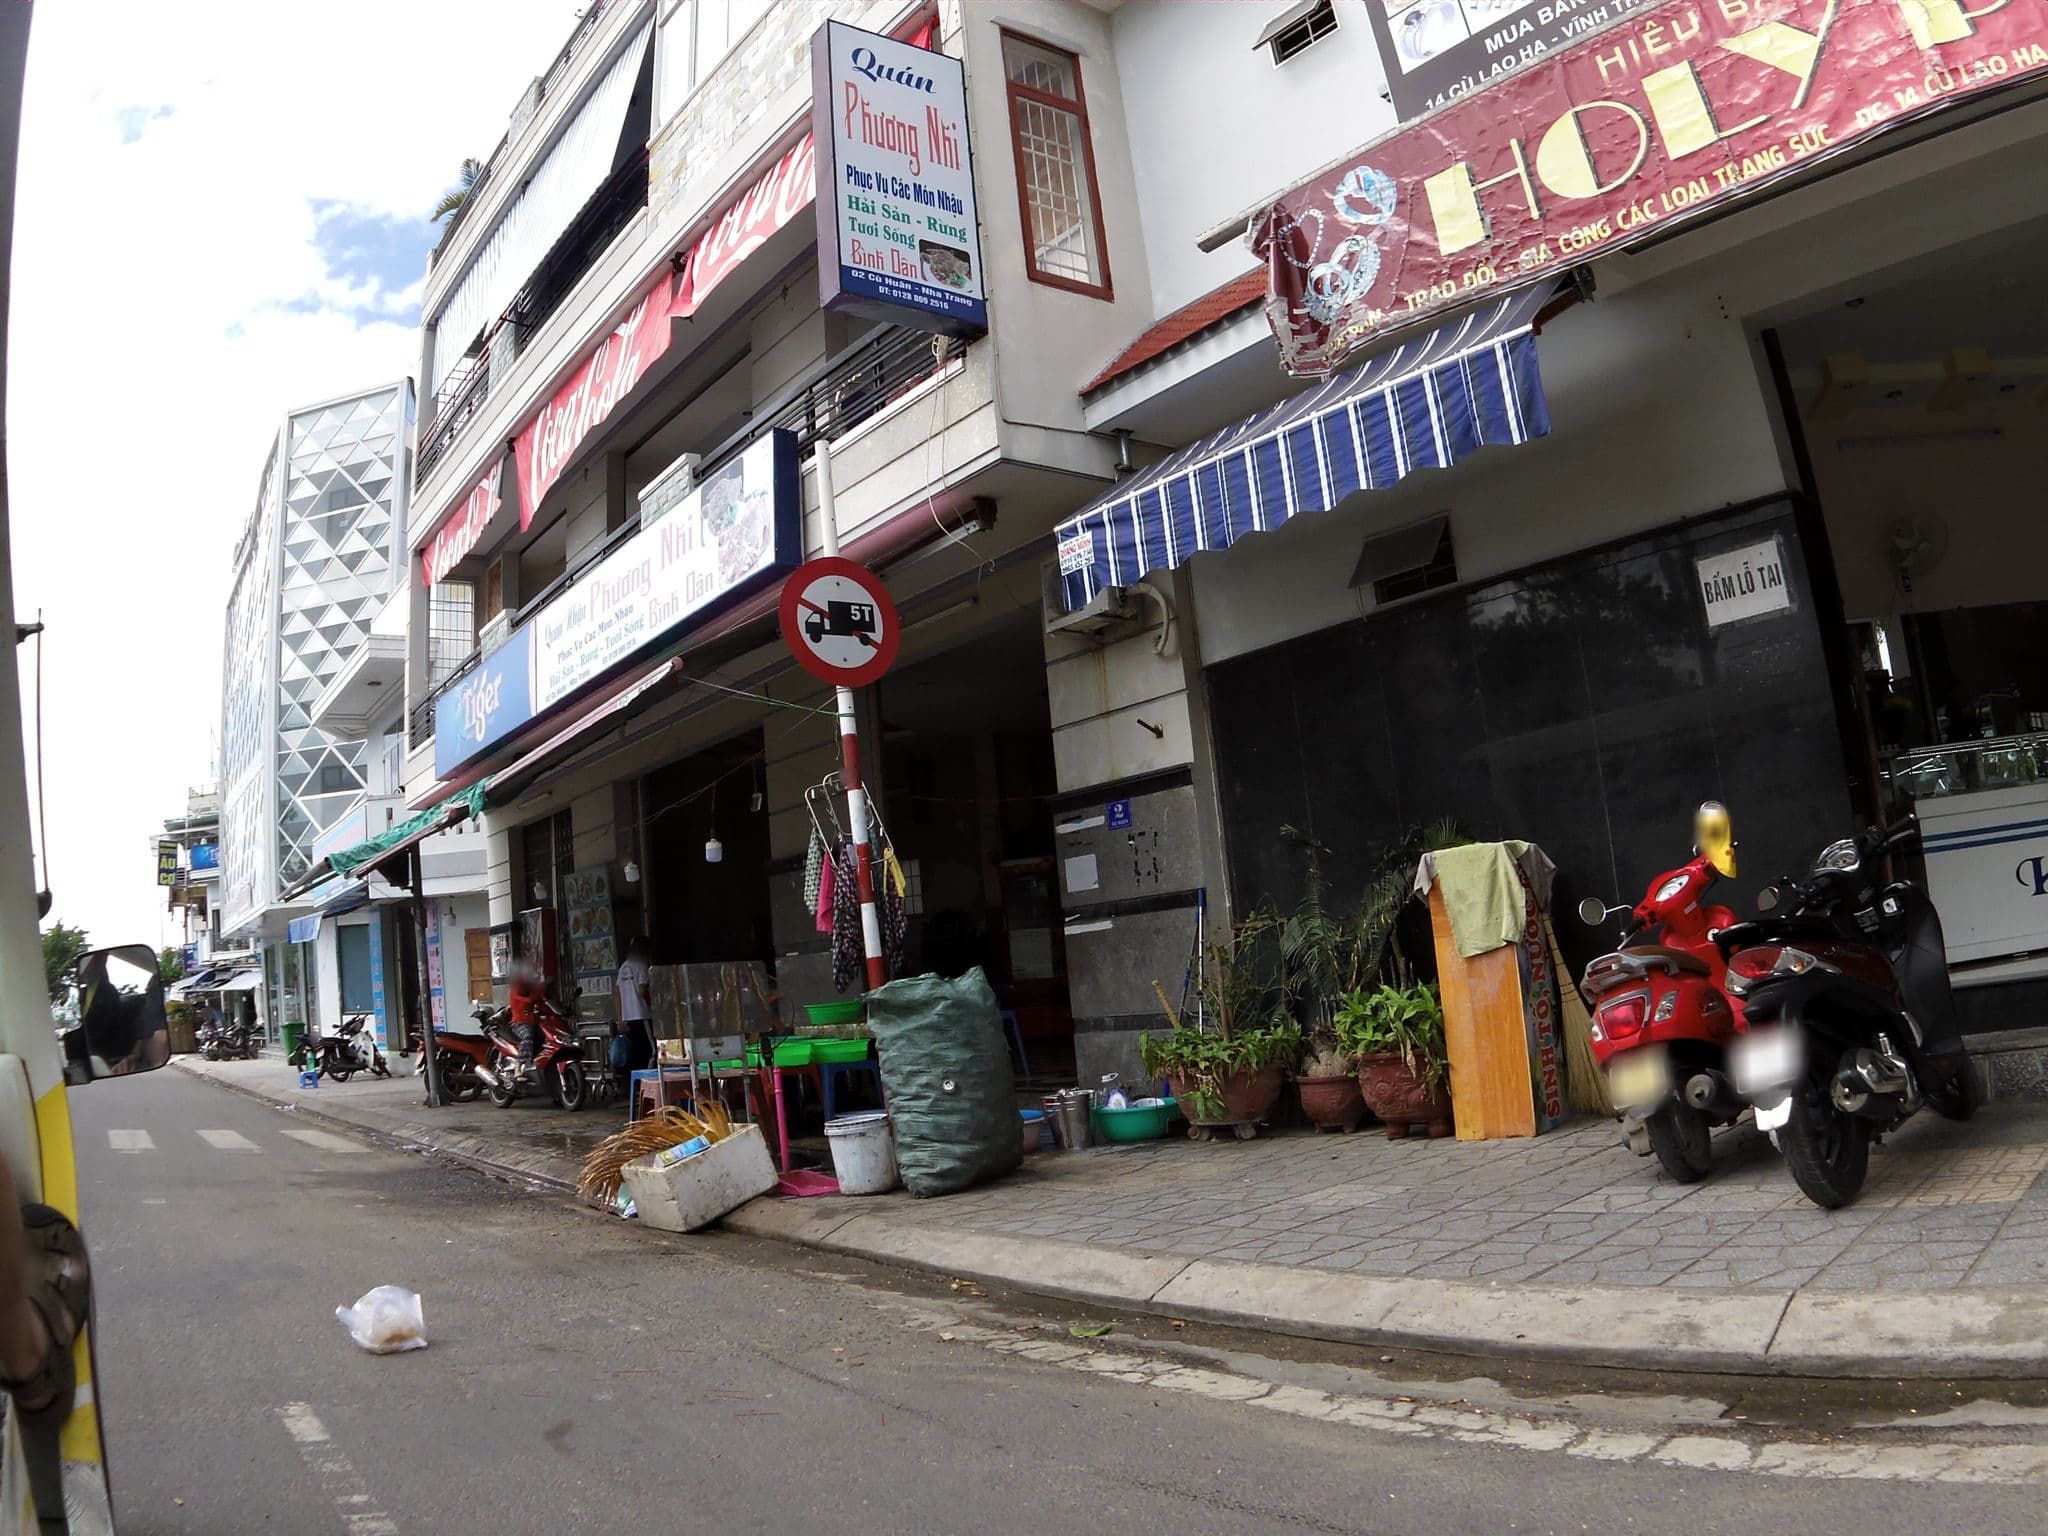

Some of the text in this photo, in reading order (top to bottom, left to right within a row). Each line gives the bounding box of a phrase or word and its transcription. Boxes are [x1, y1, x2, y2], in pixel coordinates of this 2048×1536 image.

[1449, 75, 1474, 98] CÙ
[1478, 55, 1516, 82] LAO
[1560, 6, 1608, 38] VĨNH
[1484, 17, 1534, 54] MUA
[851, 48, 936, 93] Quán
[844, 80, 960, 177] Phương Nhi
[846, 164, 963, 218] Phục Vụ Các Món Nhậu
[847, 194, 967, 243] Hải Sản Rừng
[848, 216, 915, 250] Tươi Sống
[1404, 280, 1456, 312] TRAO
[1558, 217, 1612, 254] CÔNG
[1617, 199, 1658, 231] CÁC
[1712, 145, 1786, 188] TRANG
[851, 238, 917, 280] Bình Dân
[851, 269, 866, 279] 02
[921, 286, 942, 298] Nha
[944, 292, 973, 307] Trang
[1703, 560, 1782, 604] BẤM LỖ TAI
[850, 604, 872, 622] 5T
[462, 669, 503, 742] Tiger
[1541, 1046, 1561, 1119] SINH
